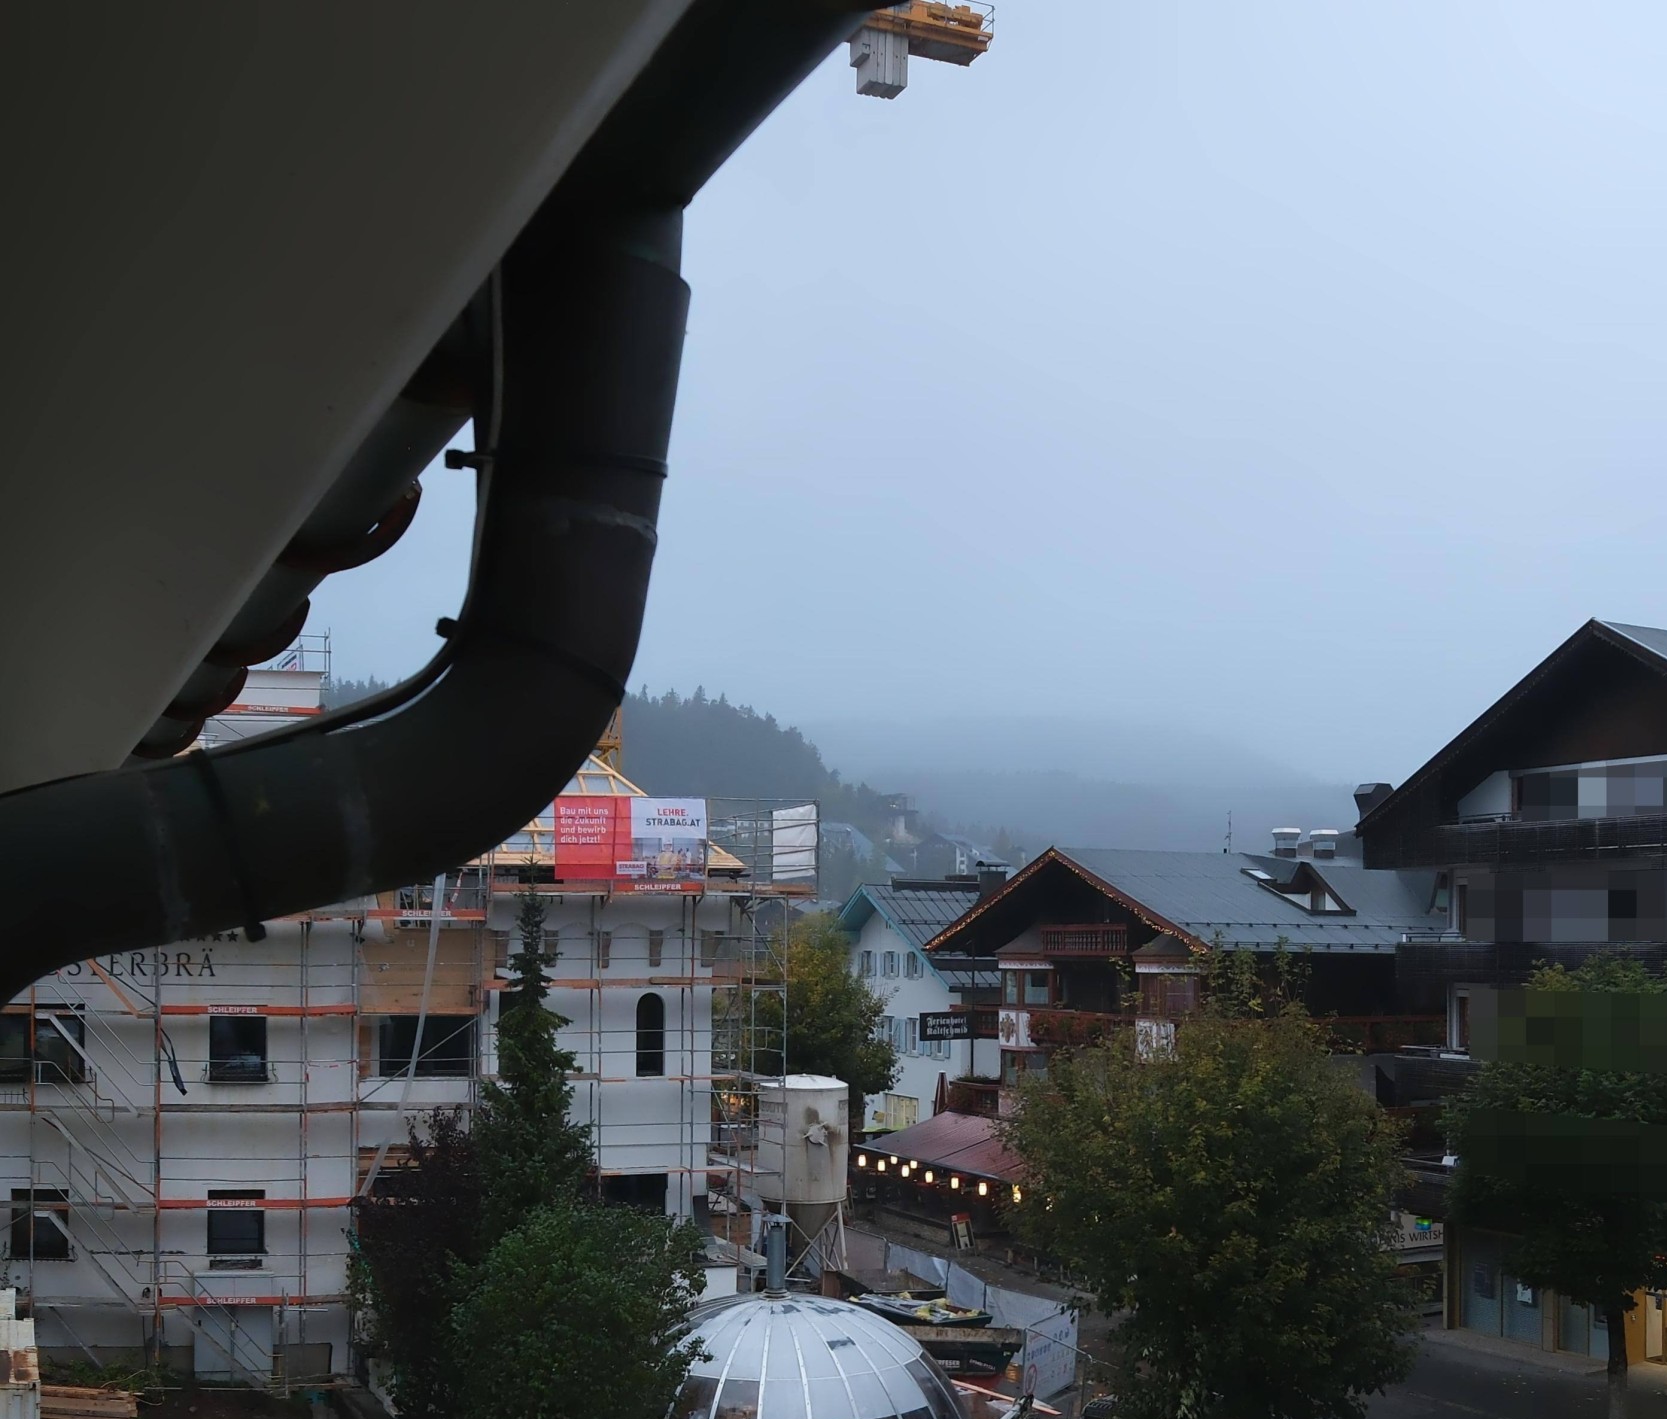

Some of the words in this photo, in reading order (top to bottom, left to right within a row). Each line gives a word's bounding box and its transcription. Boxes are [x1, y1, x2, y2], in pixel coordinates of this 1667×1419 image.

[560, 806, 577, 815] Bau
[578, 806, 592, 815] mit
[594, 807, 609, 815] uns
[657, 808, 689, 817] LEHRE.
[560, 816, 573, 825] die
[574, 816, 606, 825] Zukunft
[645, 817, 701, 827] STRABAG.AT
[560, 826, 575, 834] und
[577, 826, 606, 834] bewirb
[560, 835, 577, 843] dich
[578, 835, 601, 845] jetzt!
[634, 883, 682, 891] SCHLEIPFER
[207, 1005, 258, 1014] SCHLEIPFER
[206, 1199, 257, 1208] SCHLEIPFER
[206, 1296, 257, 1305] SCHLEIPFER
